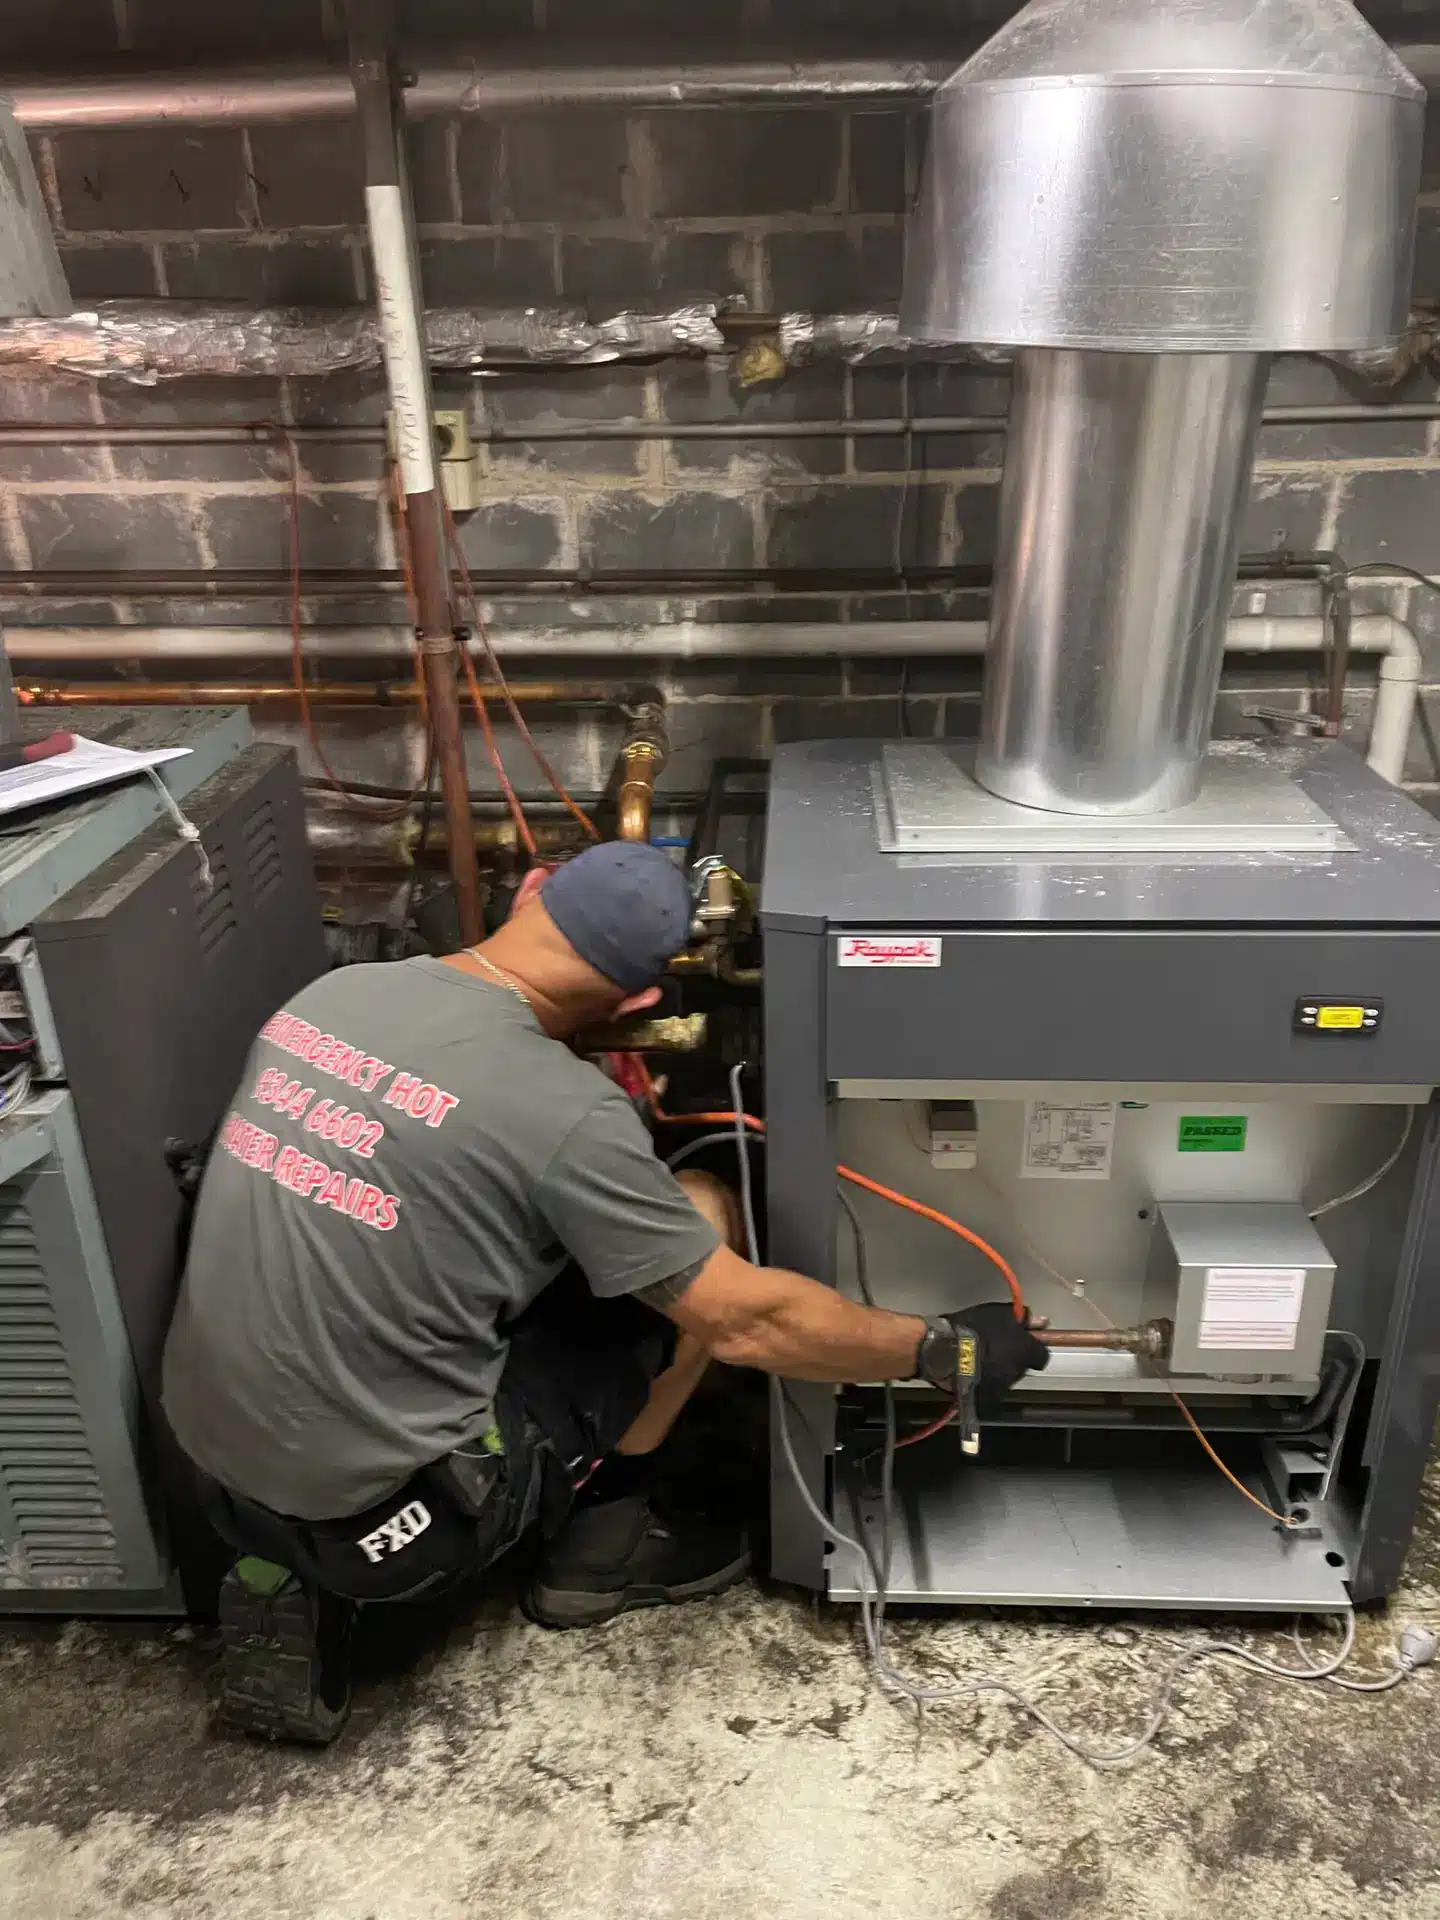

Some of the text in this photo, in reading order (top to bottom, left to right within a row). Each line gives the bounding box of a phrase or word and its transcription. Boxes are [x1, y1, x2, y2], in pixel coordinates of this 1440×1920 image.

[257, 1010, 461, 1128] EMERGENCY HOT
[303, 1099, 385, 1159] 6602
[270, 1145, 401, 1231] REPAIRS
[356, 1500, 432, 1563] FXD
